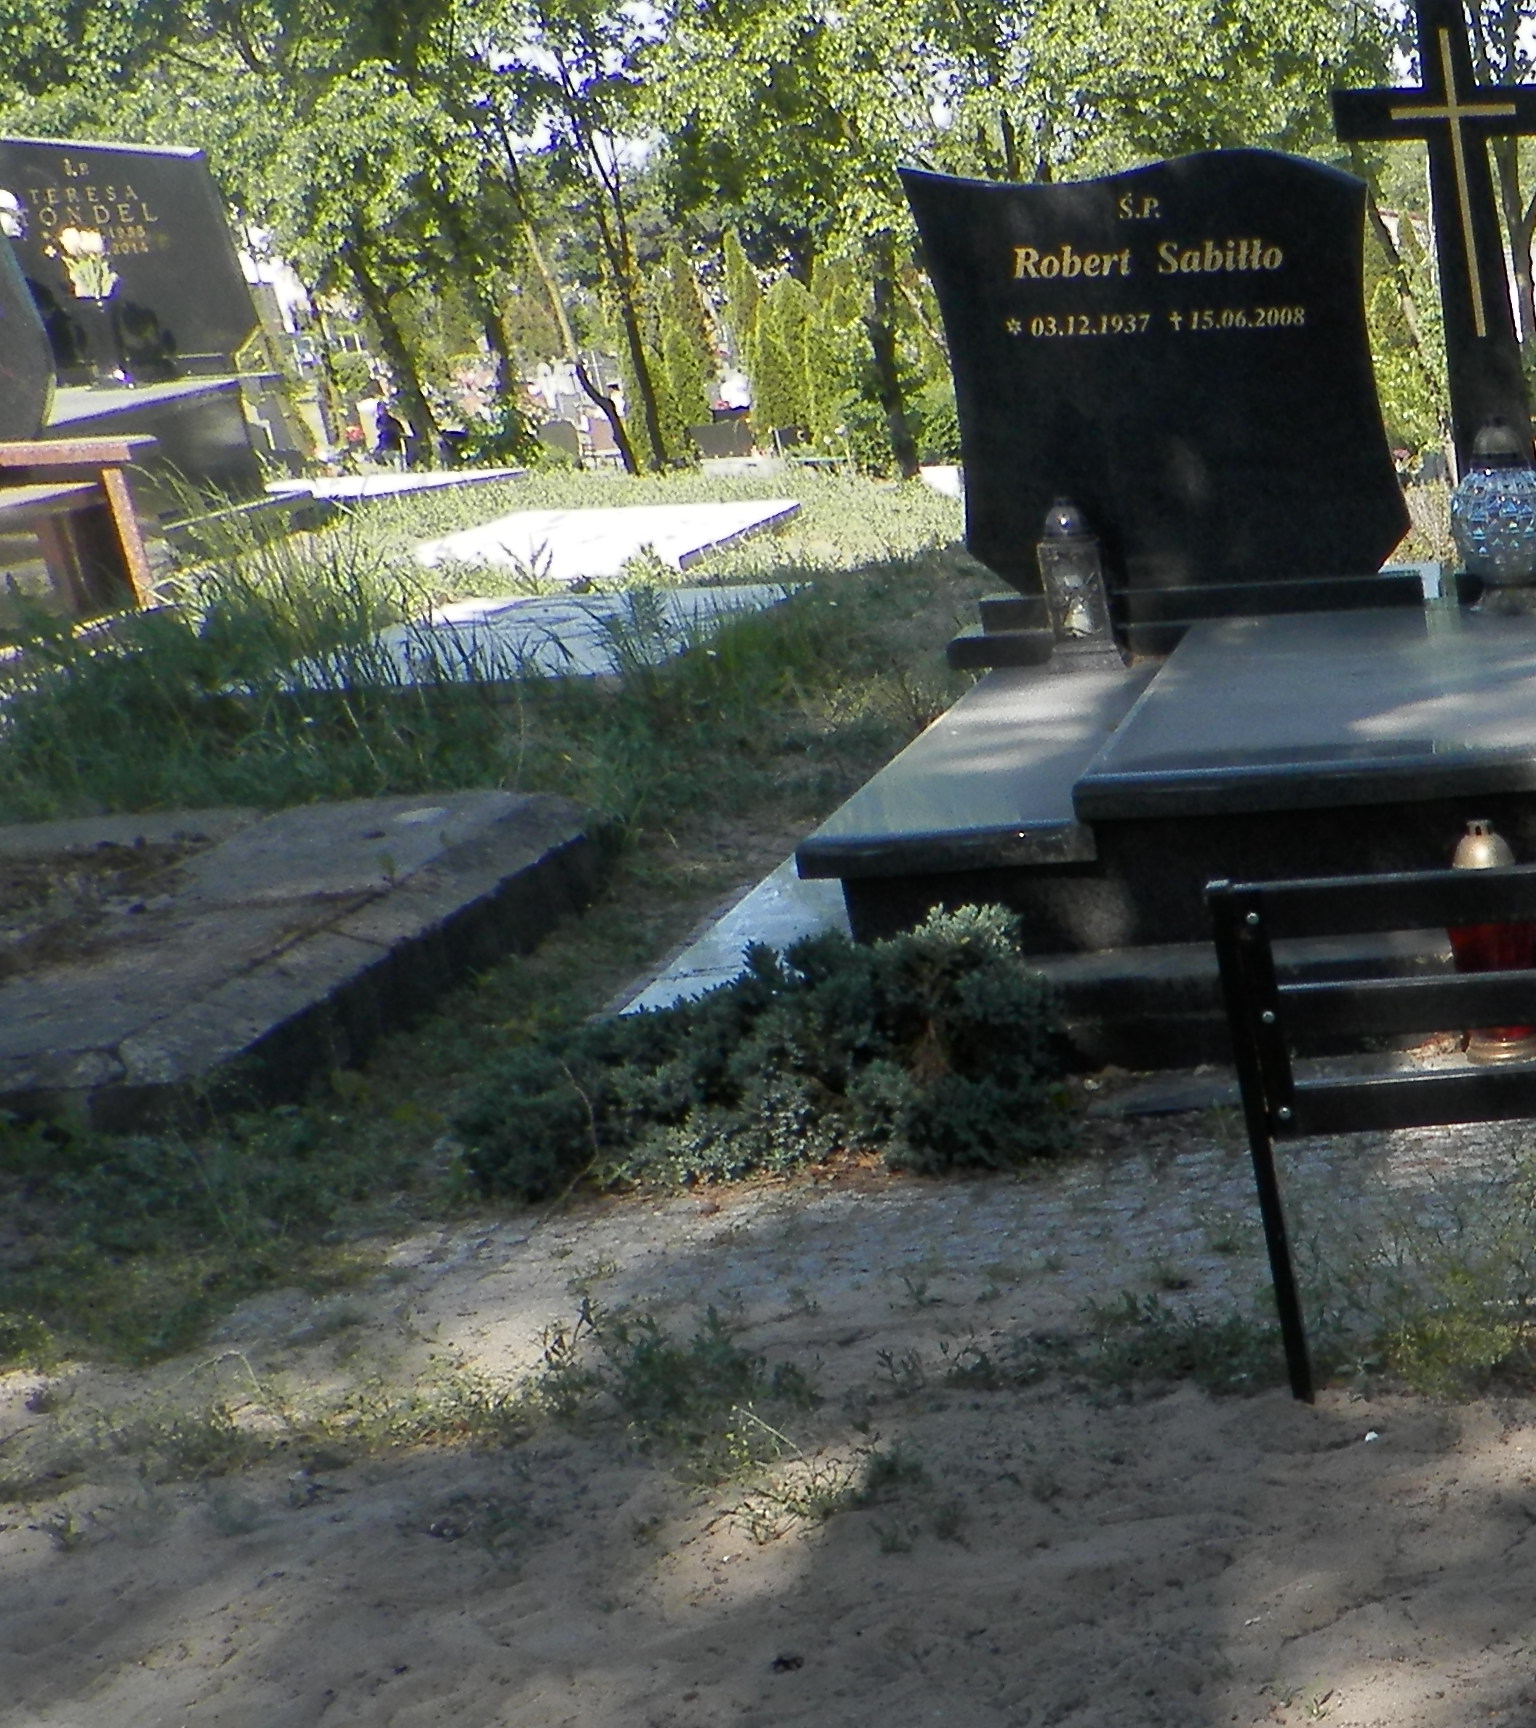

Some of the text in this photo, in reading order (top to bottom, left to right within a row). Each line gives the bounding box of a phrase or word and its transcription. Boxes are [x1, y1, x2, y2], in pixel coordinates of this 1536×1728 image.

[28, 185, 139, 204] TERESA
[1119, 192, 1161, 220] Ś.P.
[1013, 238, 1283, 280] Robert Sabiłło
[1030, 307, 1306, 338] 03.12.1937 15.06.2008
